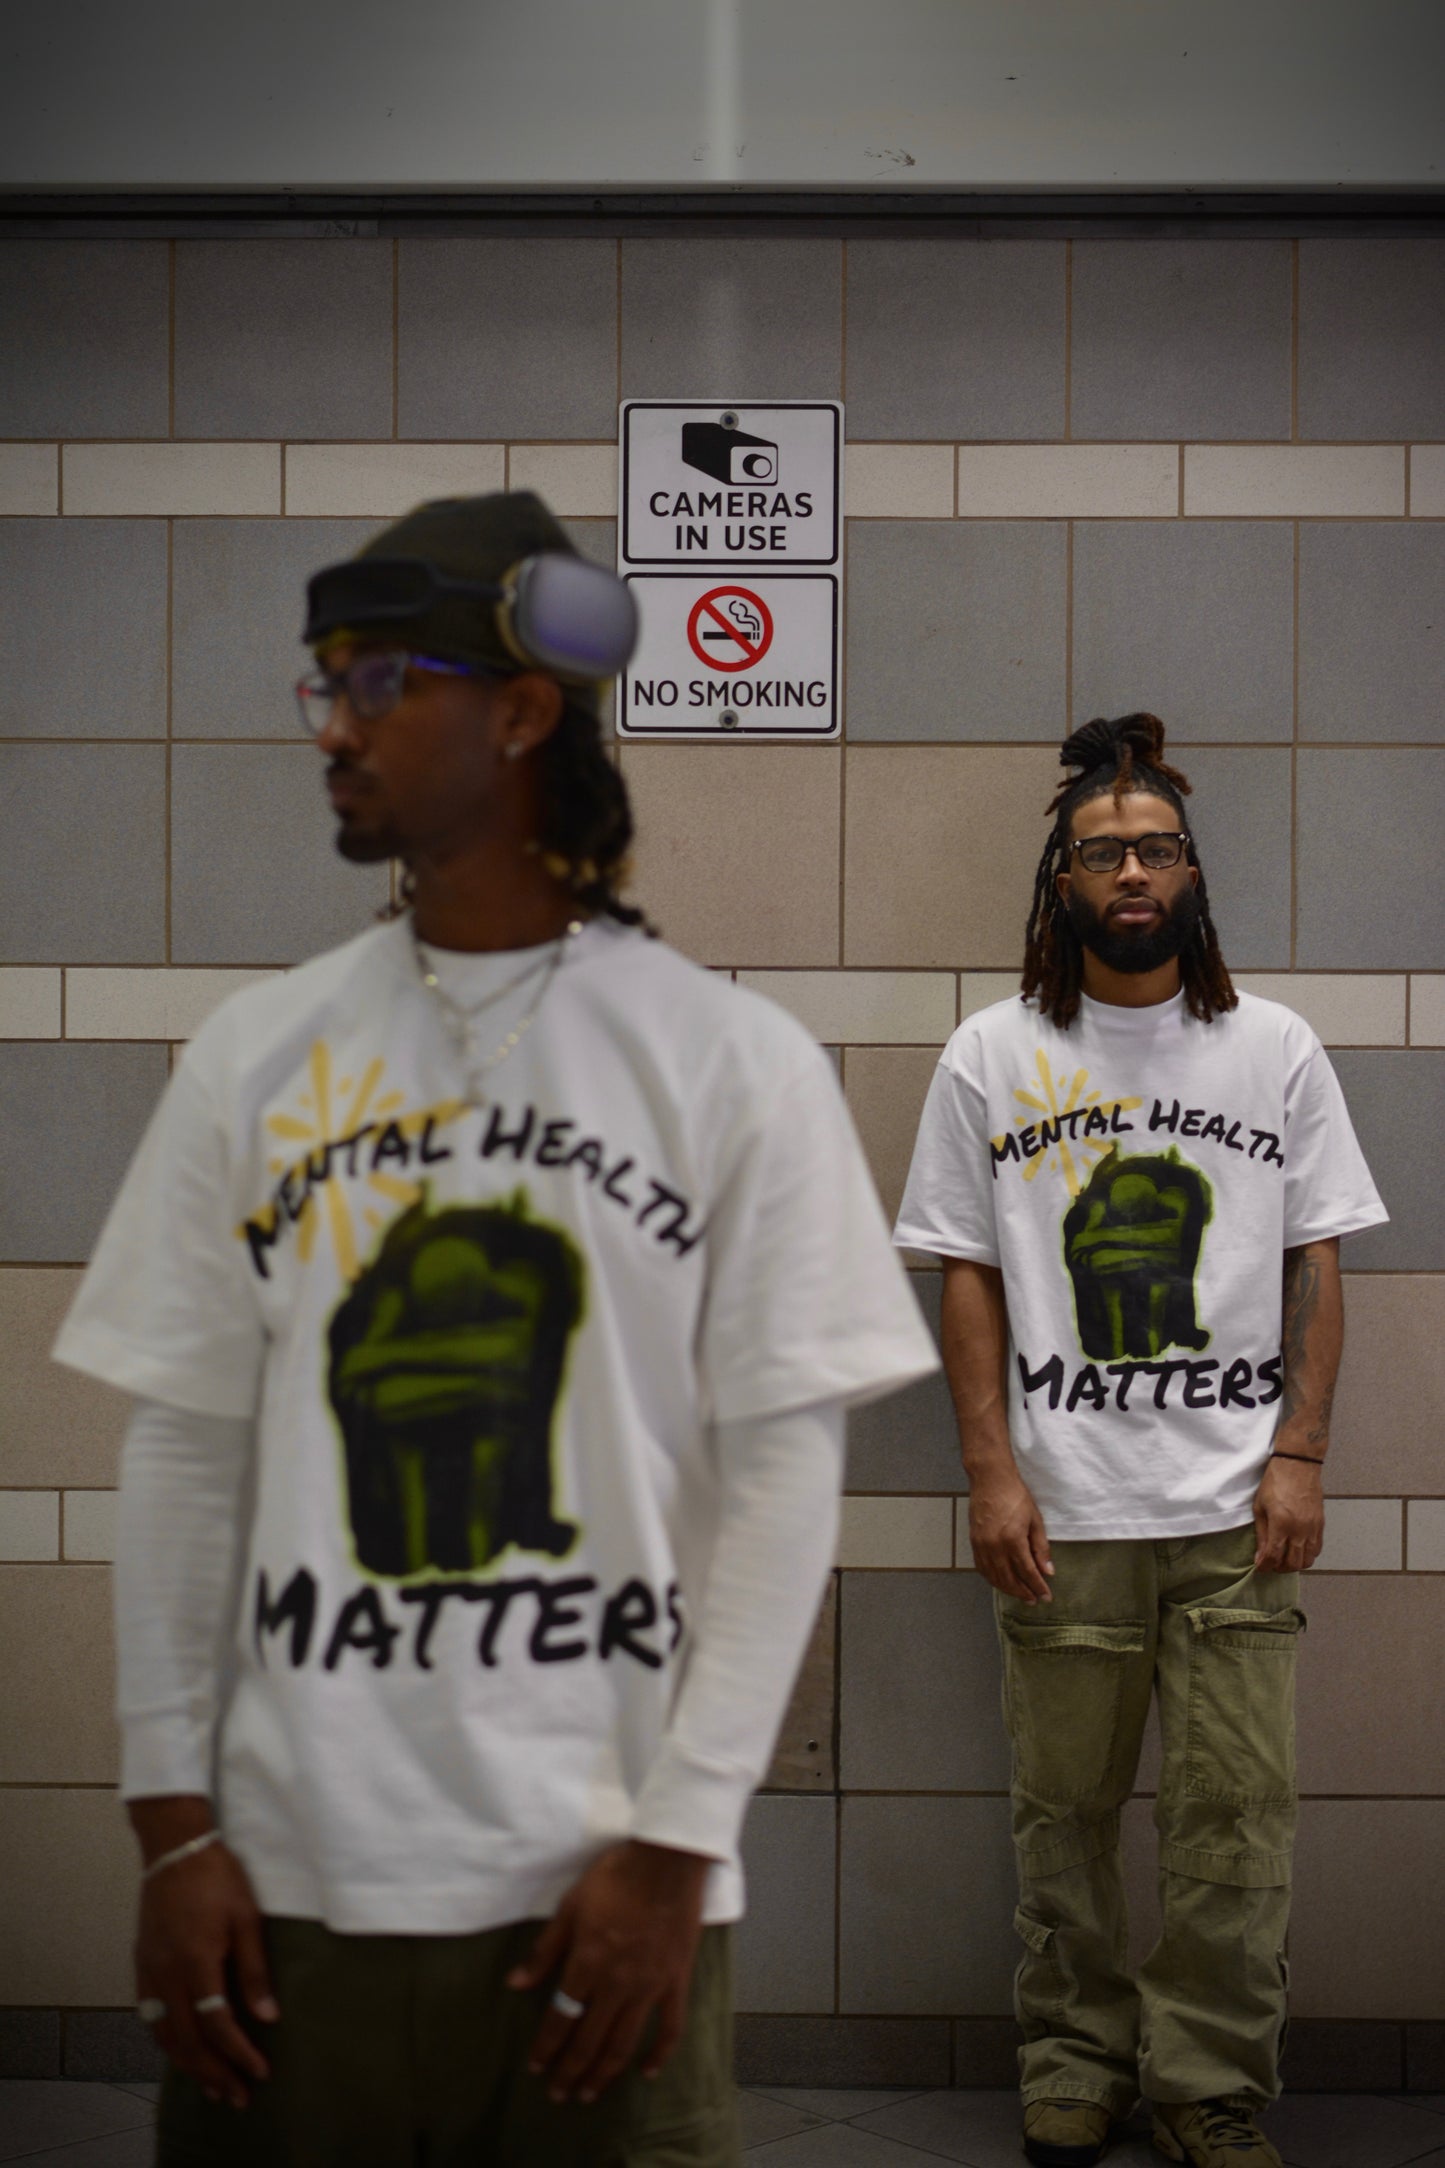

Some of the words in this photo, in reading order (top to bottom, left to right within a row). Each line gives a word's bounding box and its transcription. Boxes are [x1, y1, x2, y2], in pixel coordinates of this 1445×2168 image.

[650, 491, 813, 518] CAMERAS
[676, 525, 708, 551] IN
[724, 525, 787, 551] USE
[634, 680, 679, 706] NO
[689, 680, 827, 707] SMOKING
[991, 1104, 1133, 1179] MENTAL
[1148, 1099, 1284, 1169] HEALTH
[243, 1116, 452, 1278] MENTAL
[481, 1104, 700, 1257] HEALTH
[1018, 1352, 1283, 1413] MATTERS
